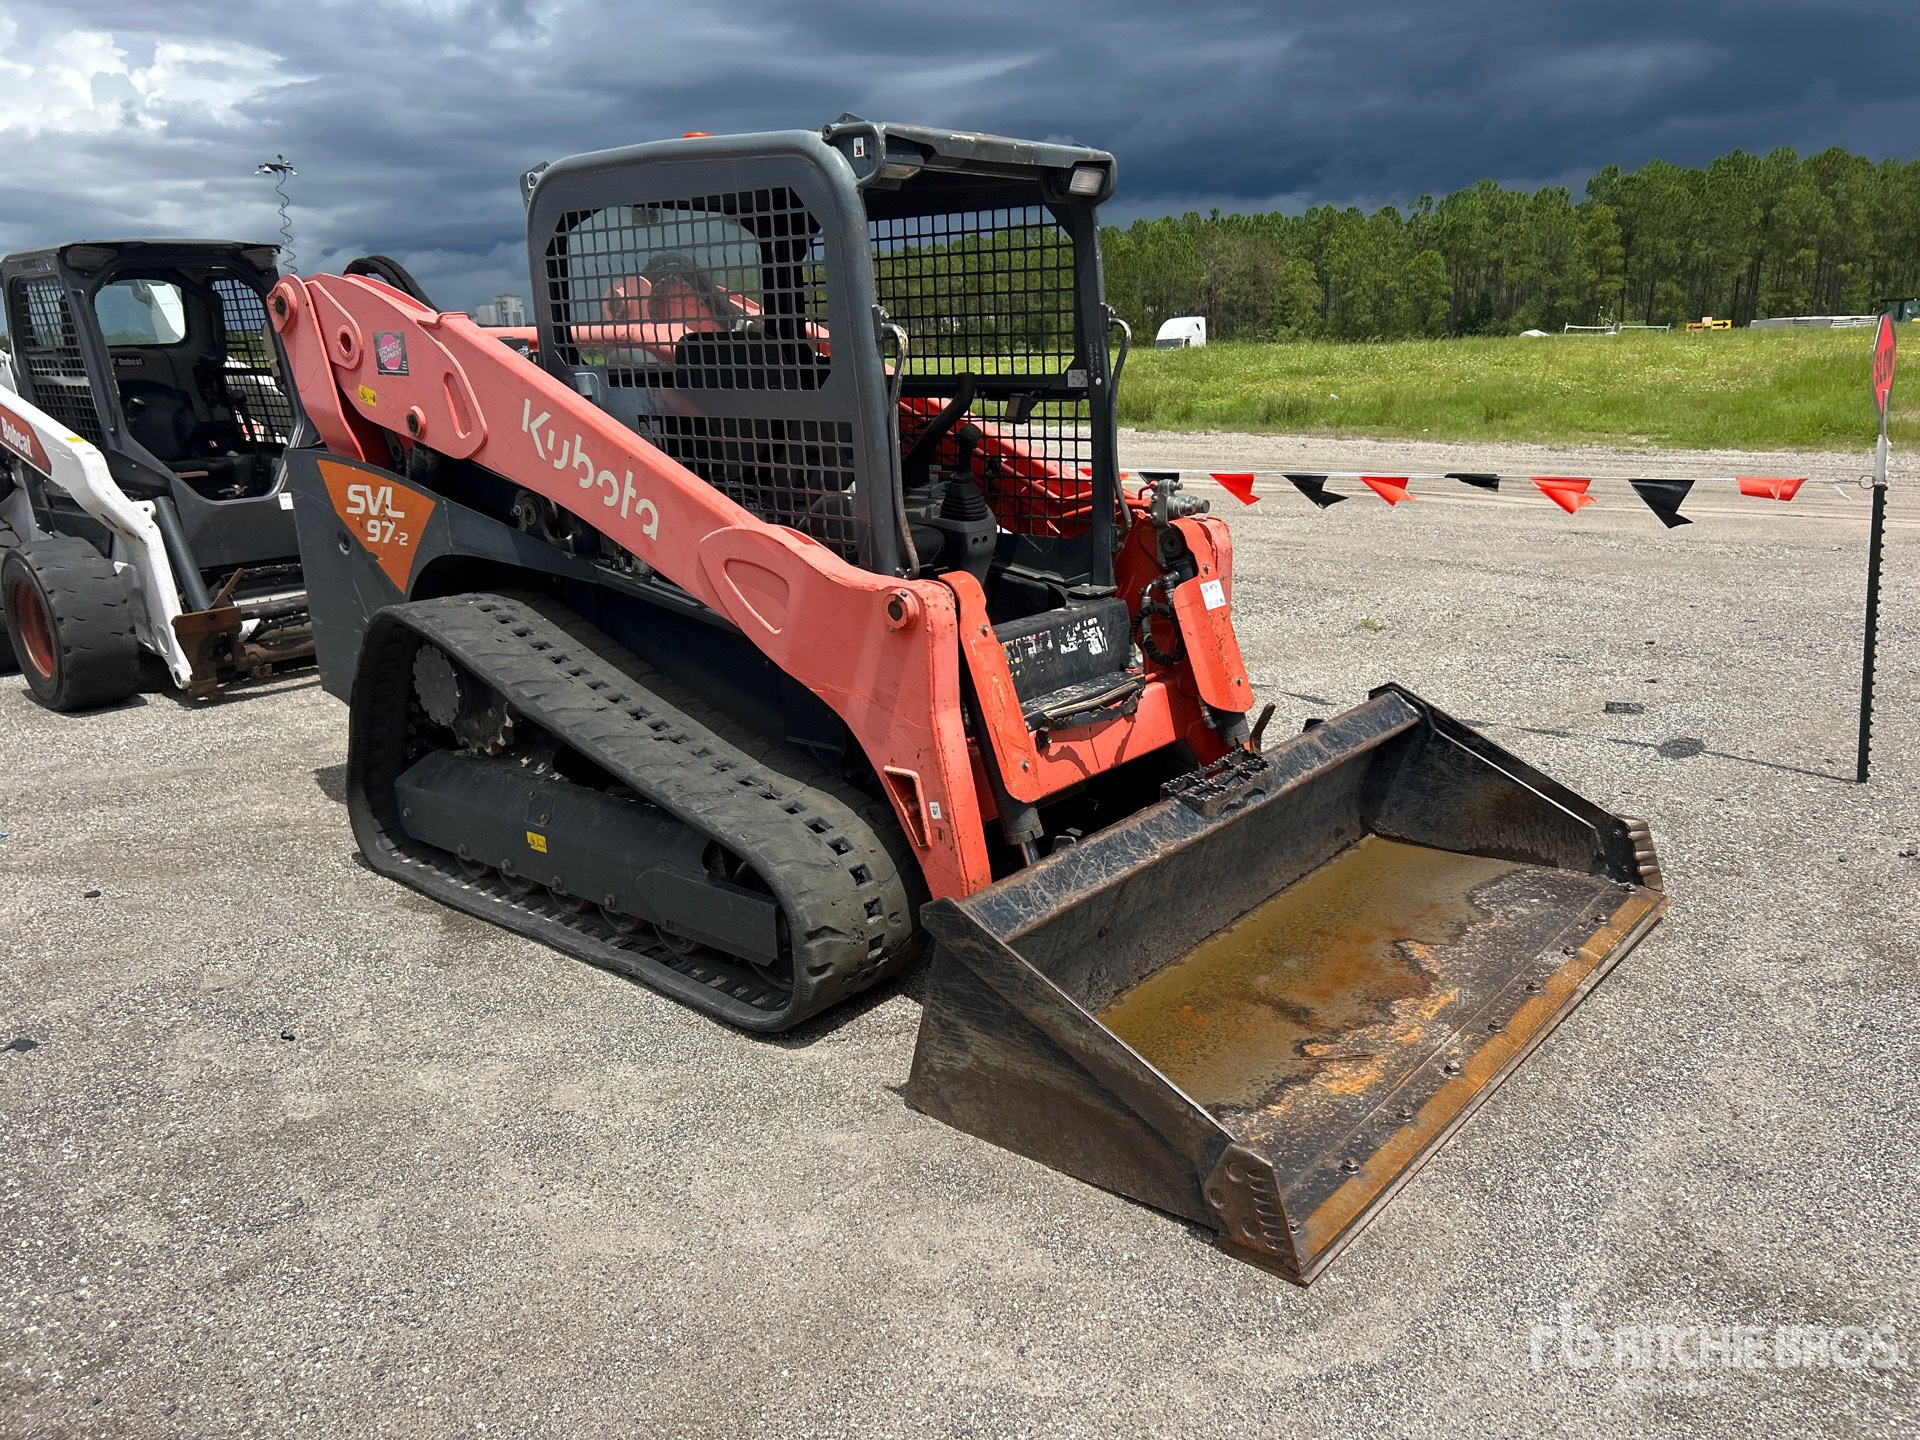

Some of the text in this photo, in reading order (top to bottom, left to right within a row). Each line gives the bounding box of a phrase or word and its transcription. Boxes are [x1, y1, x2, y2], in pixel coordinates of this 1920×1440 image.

[117, 358, 143, 366] Bobcat
[1, 416, 33, 458] Bobcat
[521, 398, 659, 542] Kubota
[346, 484, 405, 518] SVL
